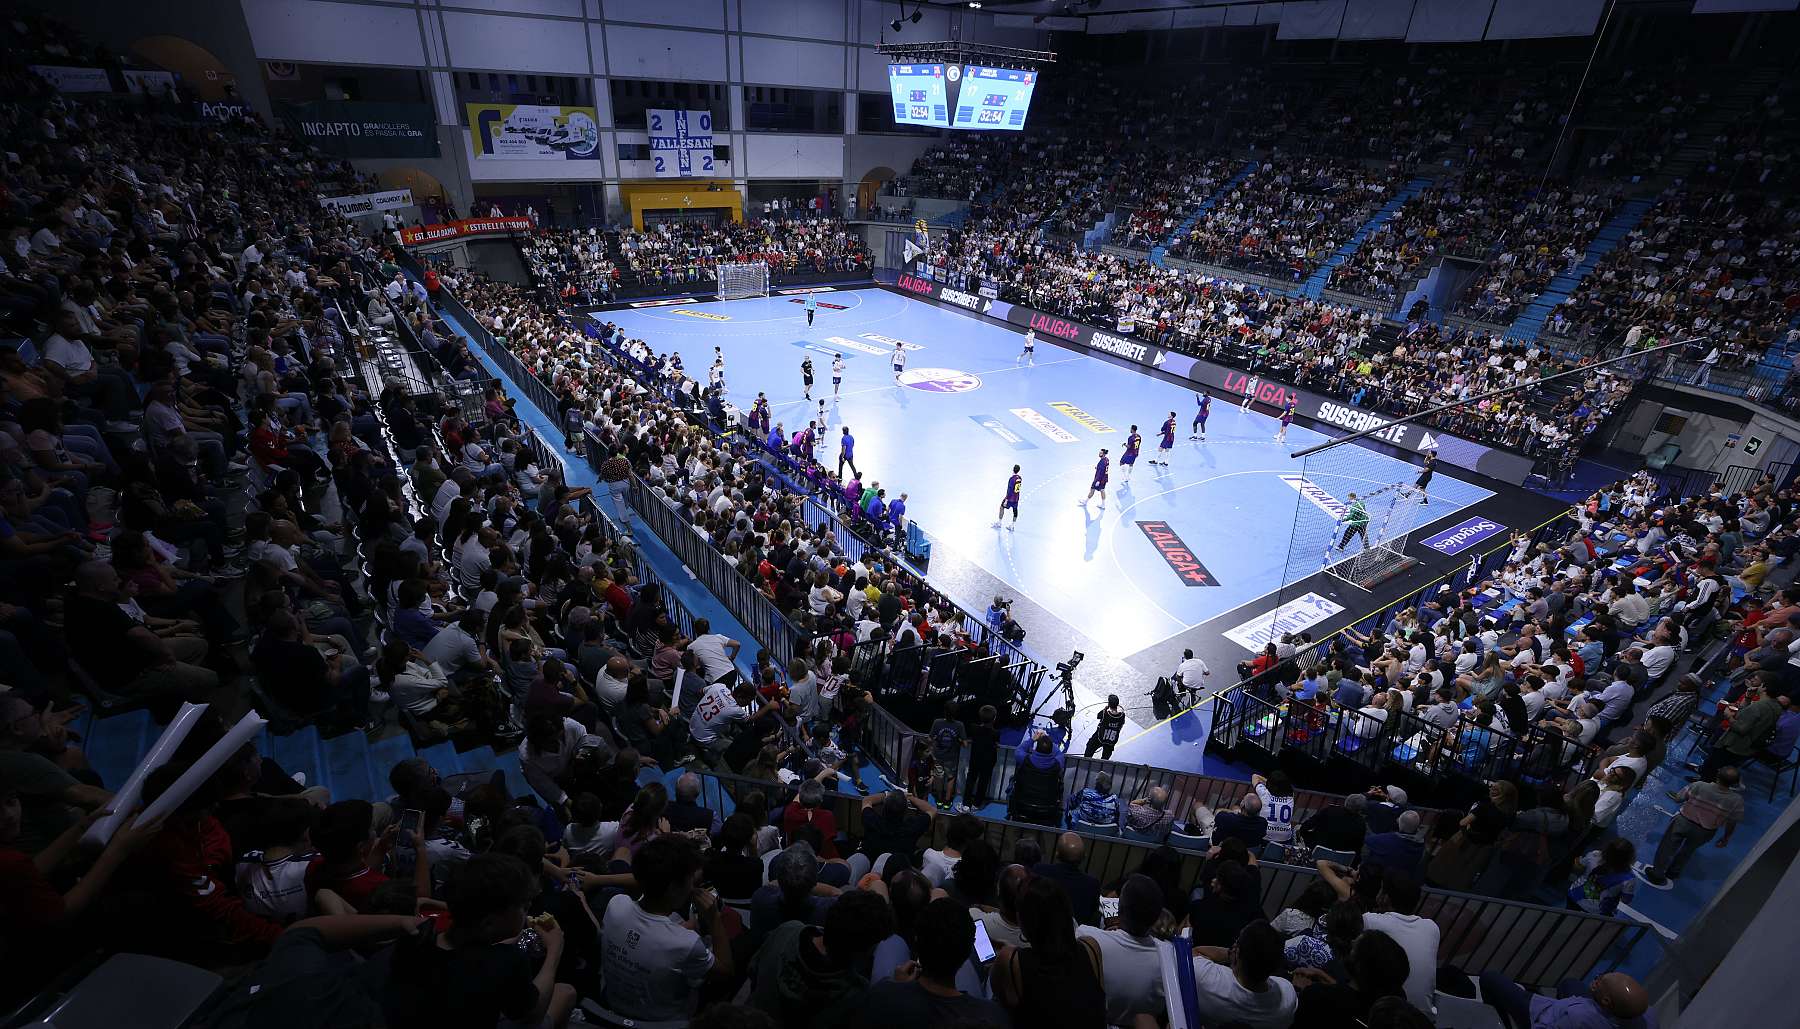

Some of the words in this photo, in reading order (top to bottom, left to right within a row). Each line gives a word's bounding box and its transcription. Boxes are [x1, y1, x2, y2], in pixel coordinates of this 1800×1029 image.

[301, 122, 360, 136] INCAPTO
[651, 115, 662, 131] 2
[700, 115, 710, 131] 0
[655, 156, 665, 172] 2
[703, 156, 713, 170] 2
[336, 198, 373, 213] hummel
[414, 230, 440, 241] ESTELLA
[440, 227, 457, 237] DAMM
[470, 222, 505, 232] ESTRELLA
[898, 275, 933, 294] LALIGA+
[940, 287, 979, 309] SUSCRÍBETE
[1029, 313, 1079, 339] LALIGA+
[1090, 331, 1147, 361] SUSCRÍBETE
[1223, 371, 1298, 407] LAIGA
[1300, 486, 1352, 518] FRAIKI
[1433, 521, 1496, 550] Sagalés
[1143, 524, 1207, 582] LALIGA+
[698, 695, 720, 722] 23
[1267, 803, 1291, 823] 10
